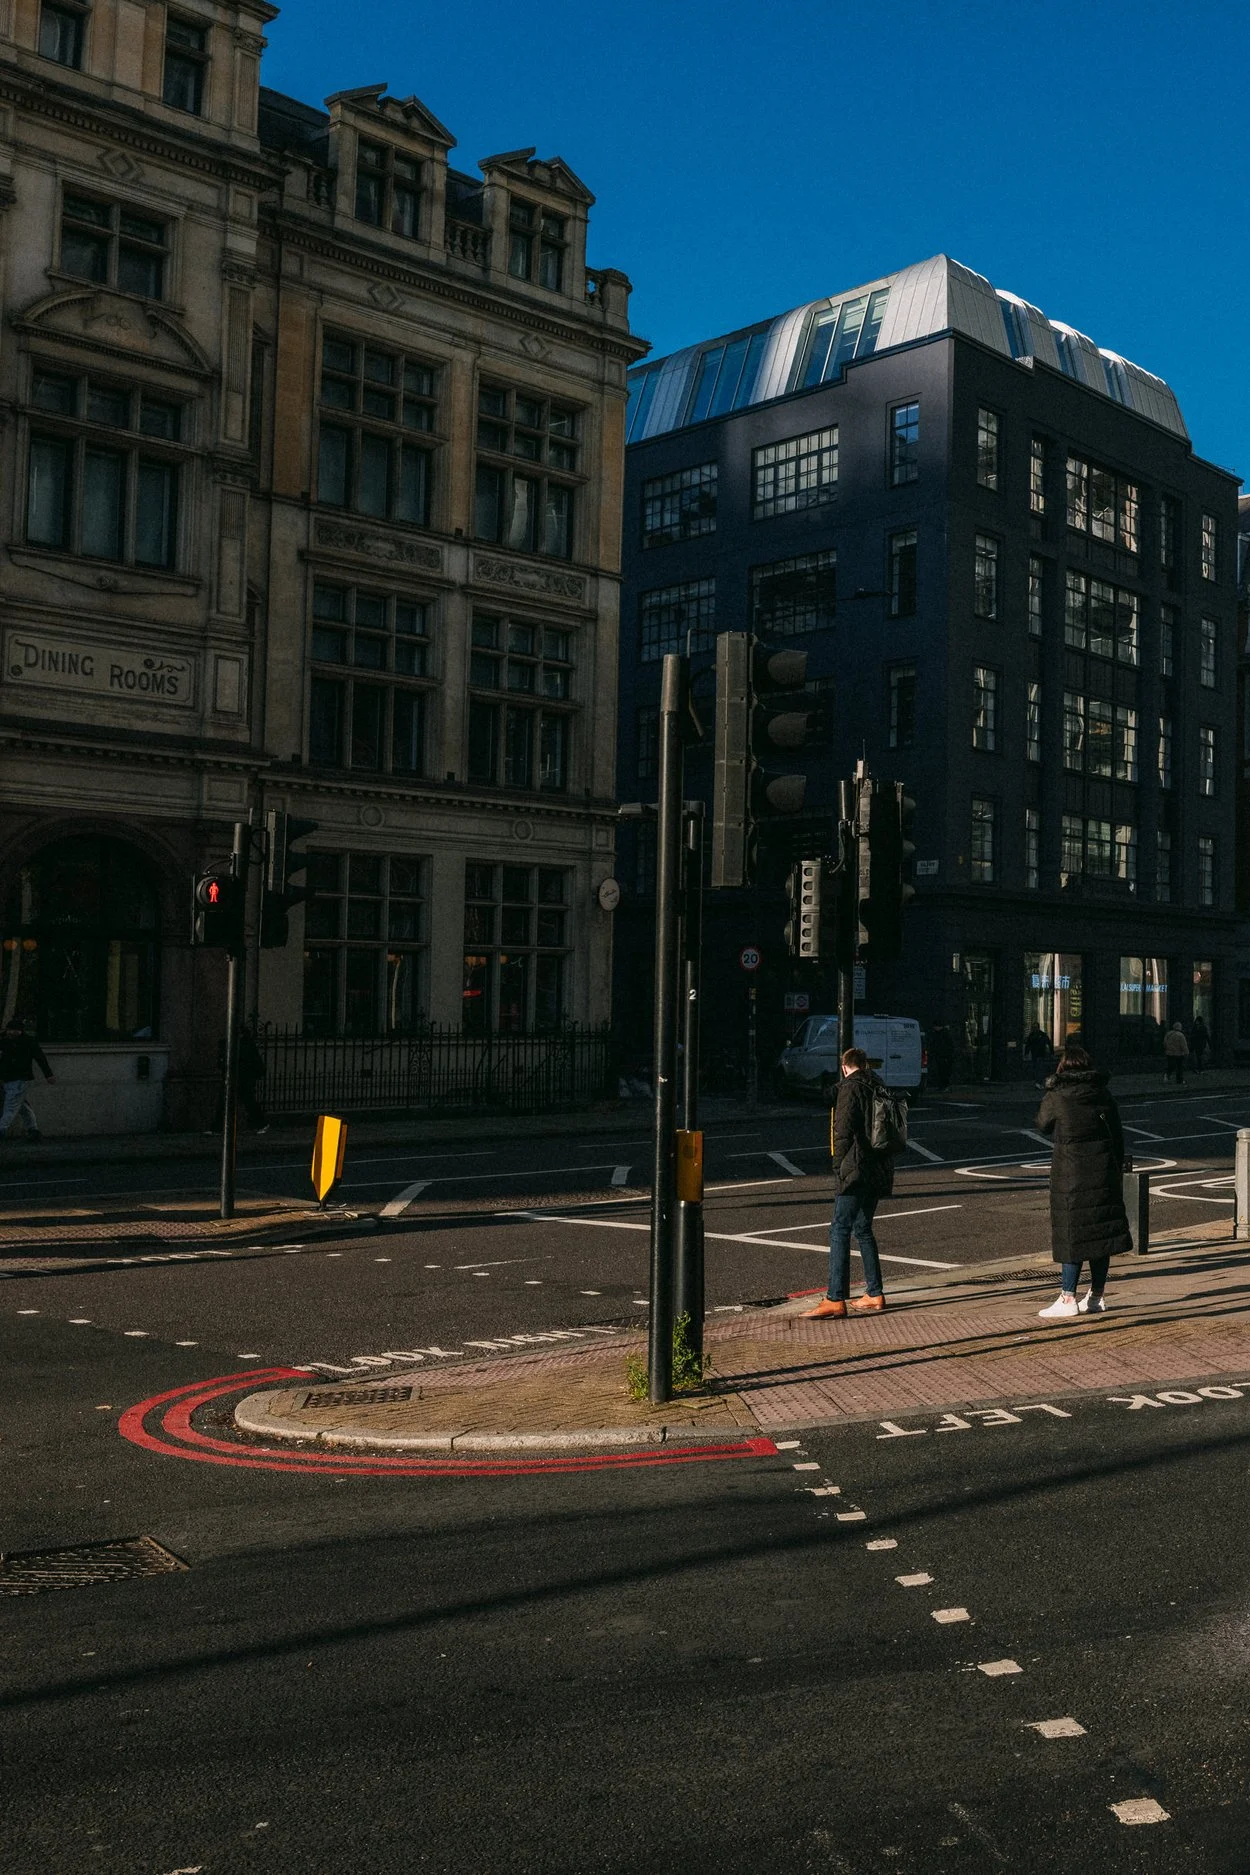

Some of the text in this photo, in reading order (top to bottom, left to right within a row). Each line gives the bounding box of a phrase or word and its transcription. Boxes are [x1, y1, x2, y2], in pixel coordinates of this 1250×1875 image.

[15, 640, 178, 695] DINING ROOMS
[743, 953, 758, 964] 20
[689, 989, 697, 1000] 2
[310, 1327, 616, 1373] LOOK RIGHT
[876, 1404, 1072, 1440] LEFT
